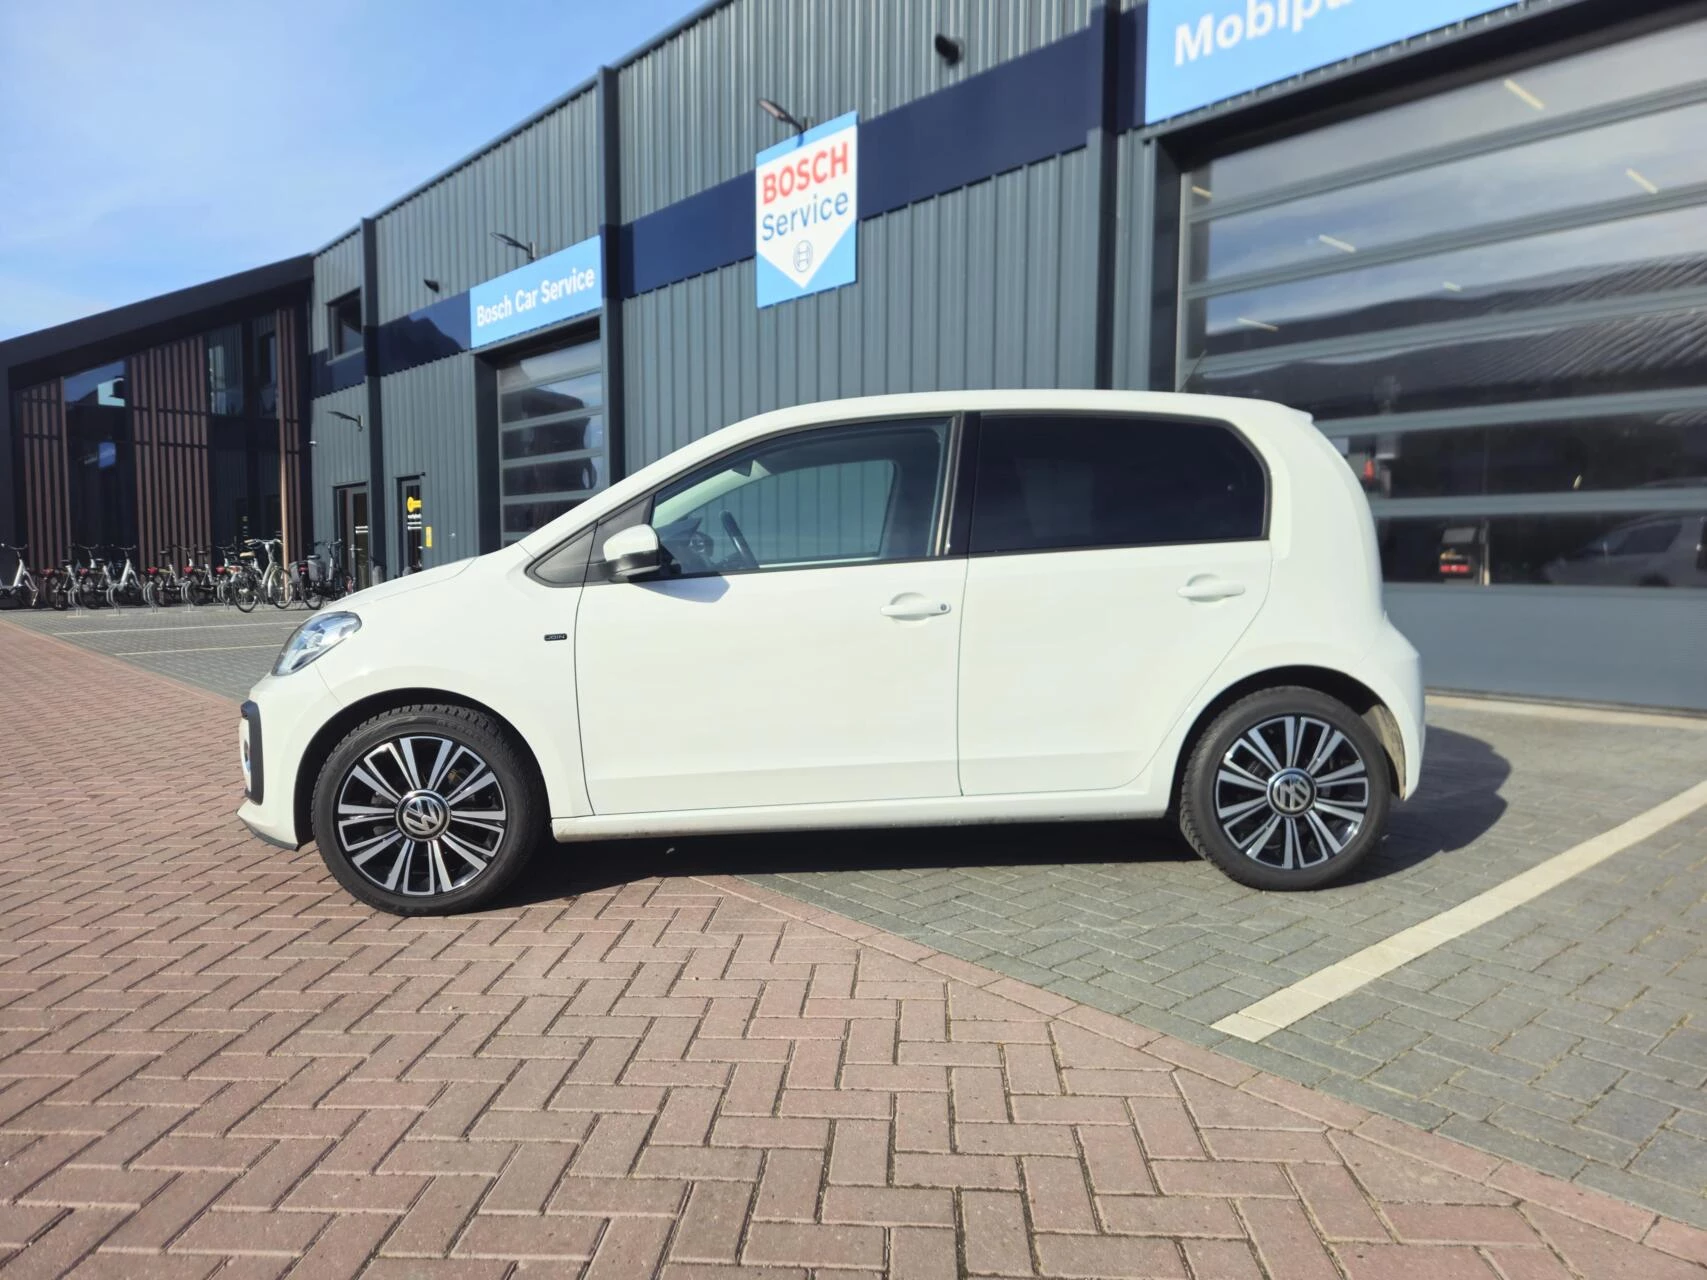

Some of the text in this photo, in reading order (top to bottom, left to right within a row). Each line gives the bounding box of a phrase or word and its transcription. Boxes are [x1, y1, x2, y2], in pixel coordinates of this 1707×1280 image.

[1174, 0, 1353, 67] Mobip
[763, 142, 849, 205] BOSCH
[762, 191, 849, 242] Service
[476, 267, 596, 327] Bosch Car Service
